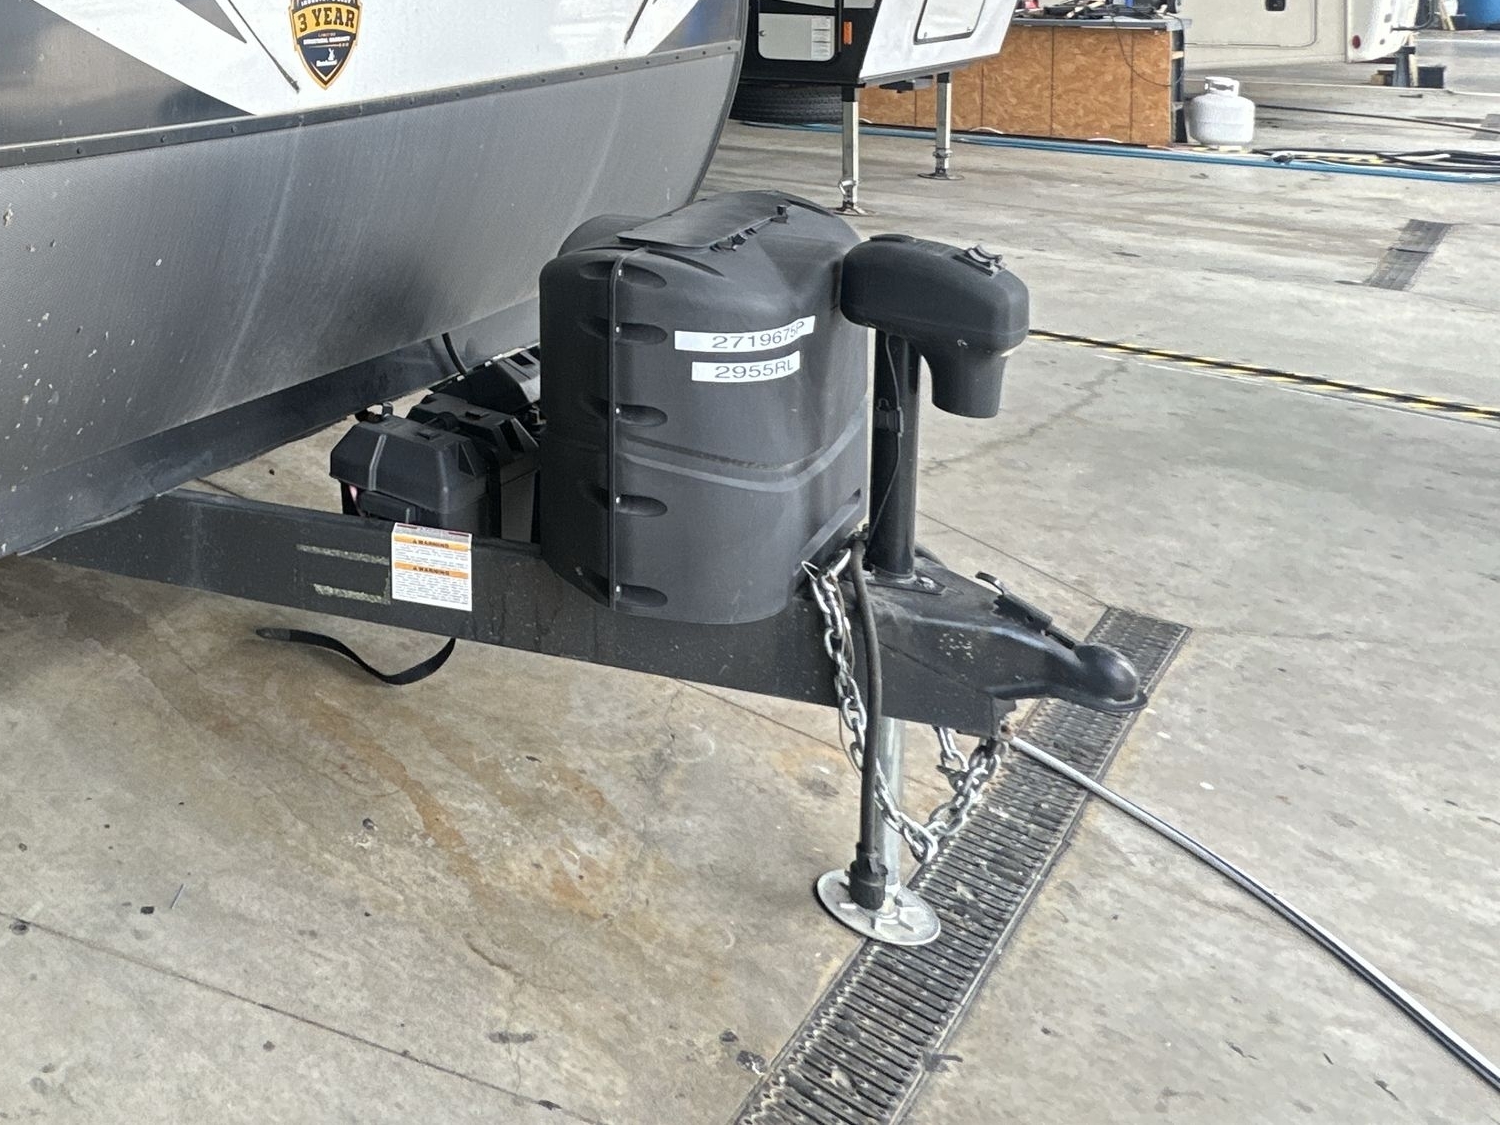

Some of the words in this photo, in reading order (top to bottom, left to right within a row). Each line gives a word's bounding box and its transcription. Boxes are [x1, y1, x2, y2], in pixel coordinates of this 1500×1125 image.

[297, 13, 308, 33] 3
[312, 7, 355, 29] YEAR
[712, 321, 805, 349] 2719675P
[714, 359, 794, 379] 2955RL
[418, 540, 449, 548] WARNING
[419, 567, 449, 576] WARNING
